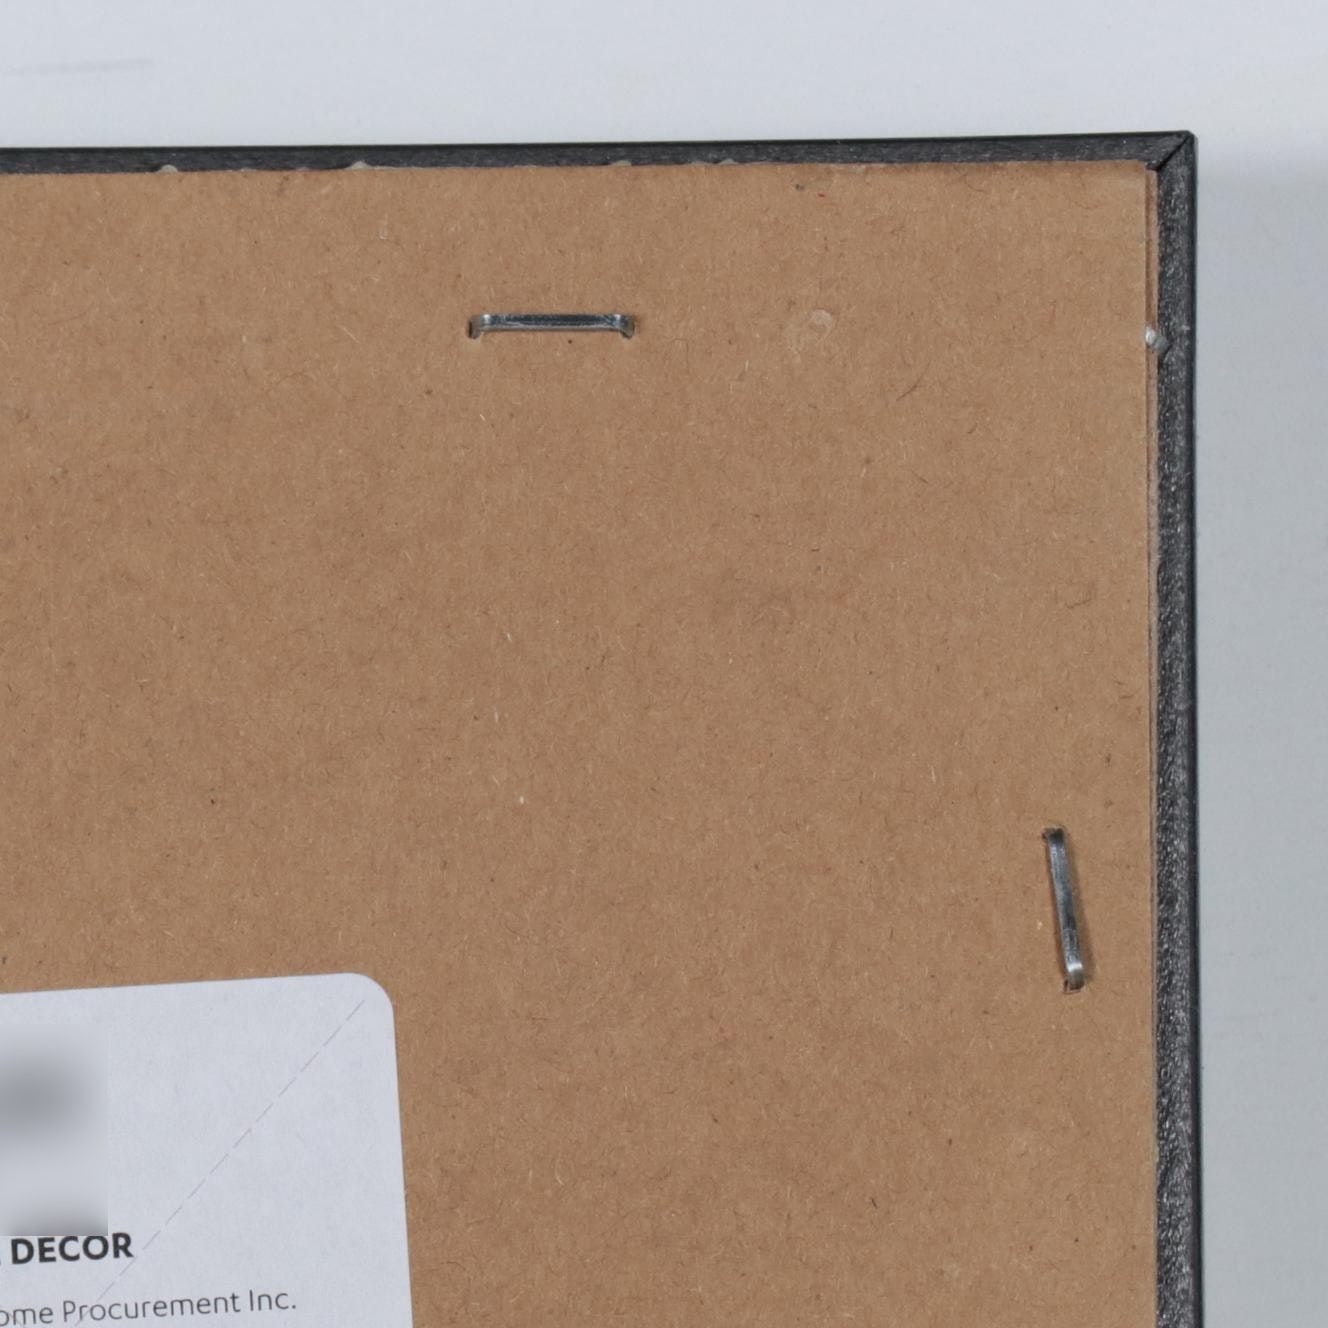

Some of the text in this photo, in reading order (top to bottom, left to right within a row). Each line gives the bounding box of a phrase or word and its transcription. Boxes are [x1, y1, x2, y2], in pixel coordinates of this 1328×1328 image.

[10, 1232, 134, 1265] DECOR
[62, 1292, 241, 1323] Procurement
[248, 1289, 298, 1312] Inc.
